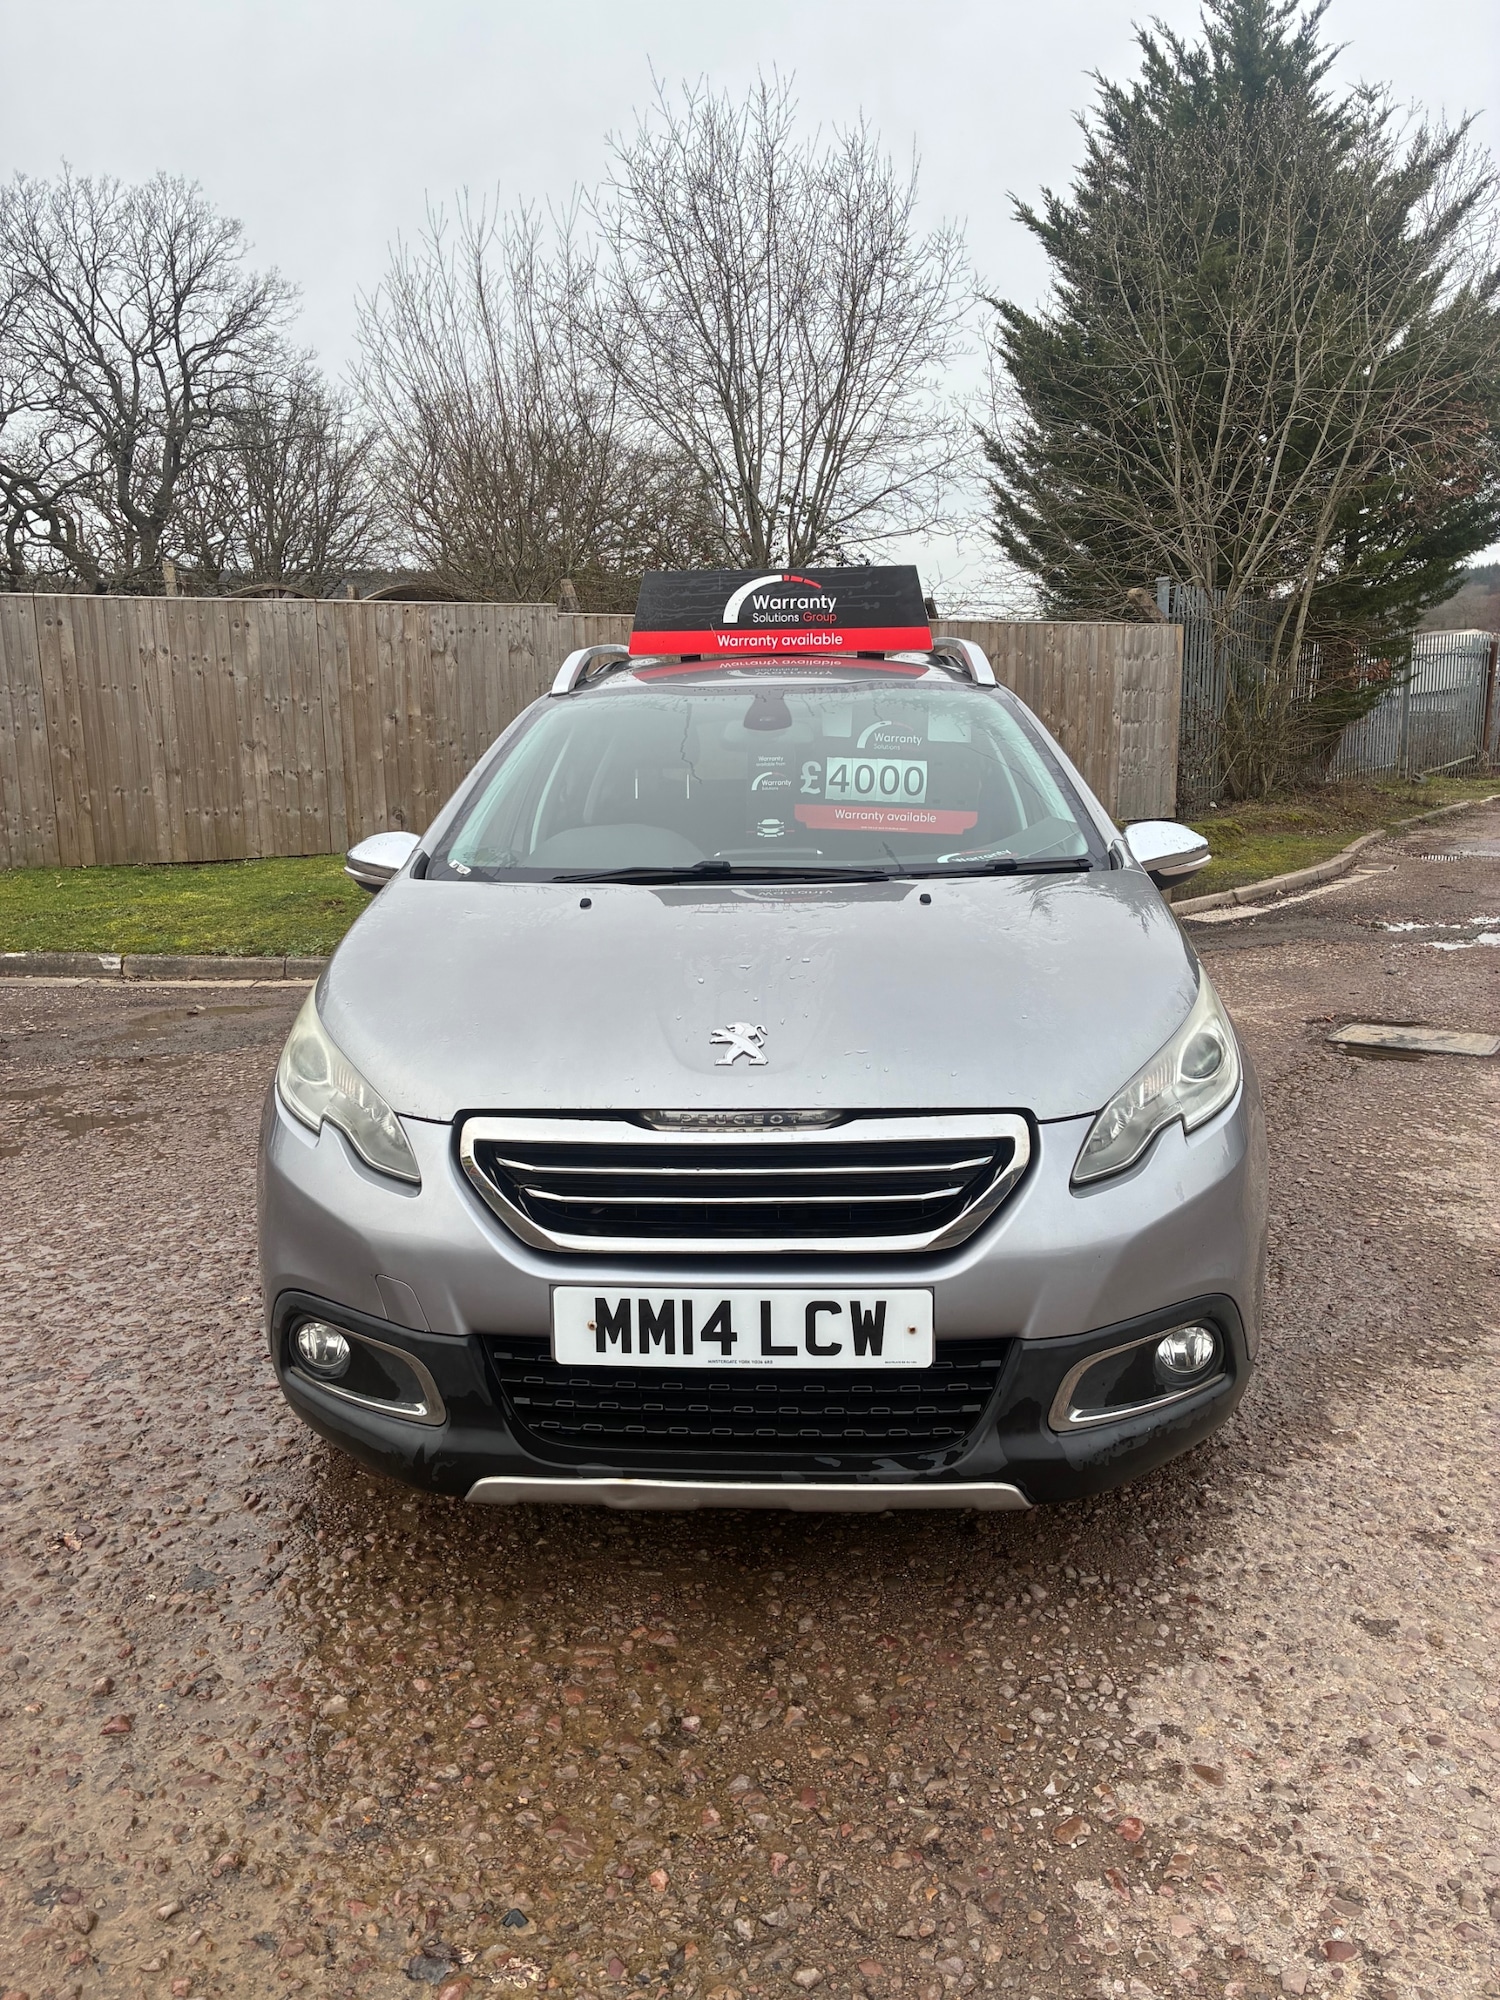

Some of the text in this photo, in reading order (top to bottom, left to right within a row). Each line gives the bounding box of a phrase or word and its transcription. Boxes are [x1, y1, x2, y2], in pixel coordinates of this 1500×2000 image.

[752, 594, 837, 613] Warranty
[752, 611, 837, 624] Solutions Group
[717, 632, 843, 649] Warranty available
[874, 733, 922, 746] Warranty
[873, 743, 901, 751] Solutions
[762, 779, 792, 787] Warranty
[835, 809, 937, 823] Warranty available
[680, 1113, 803, 1125] PEUGEOT
[595, 1298, 887, 1356] MM14 LCW
